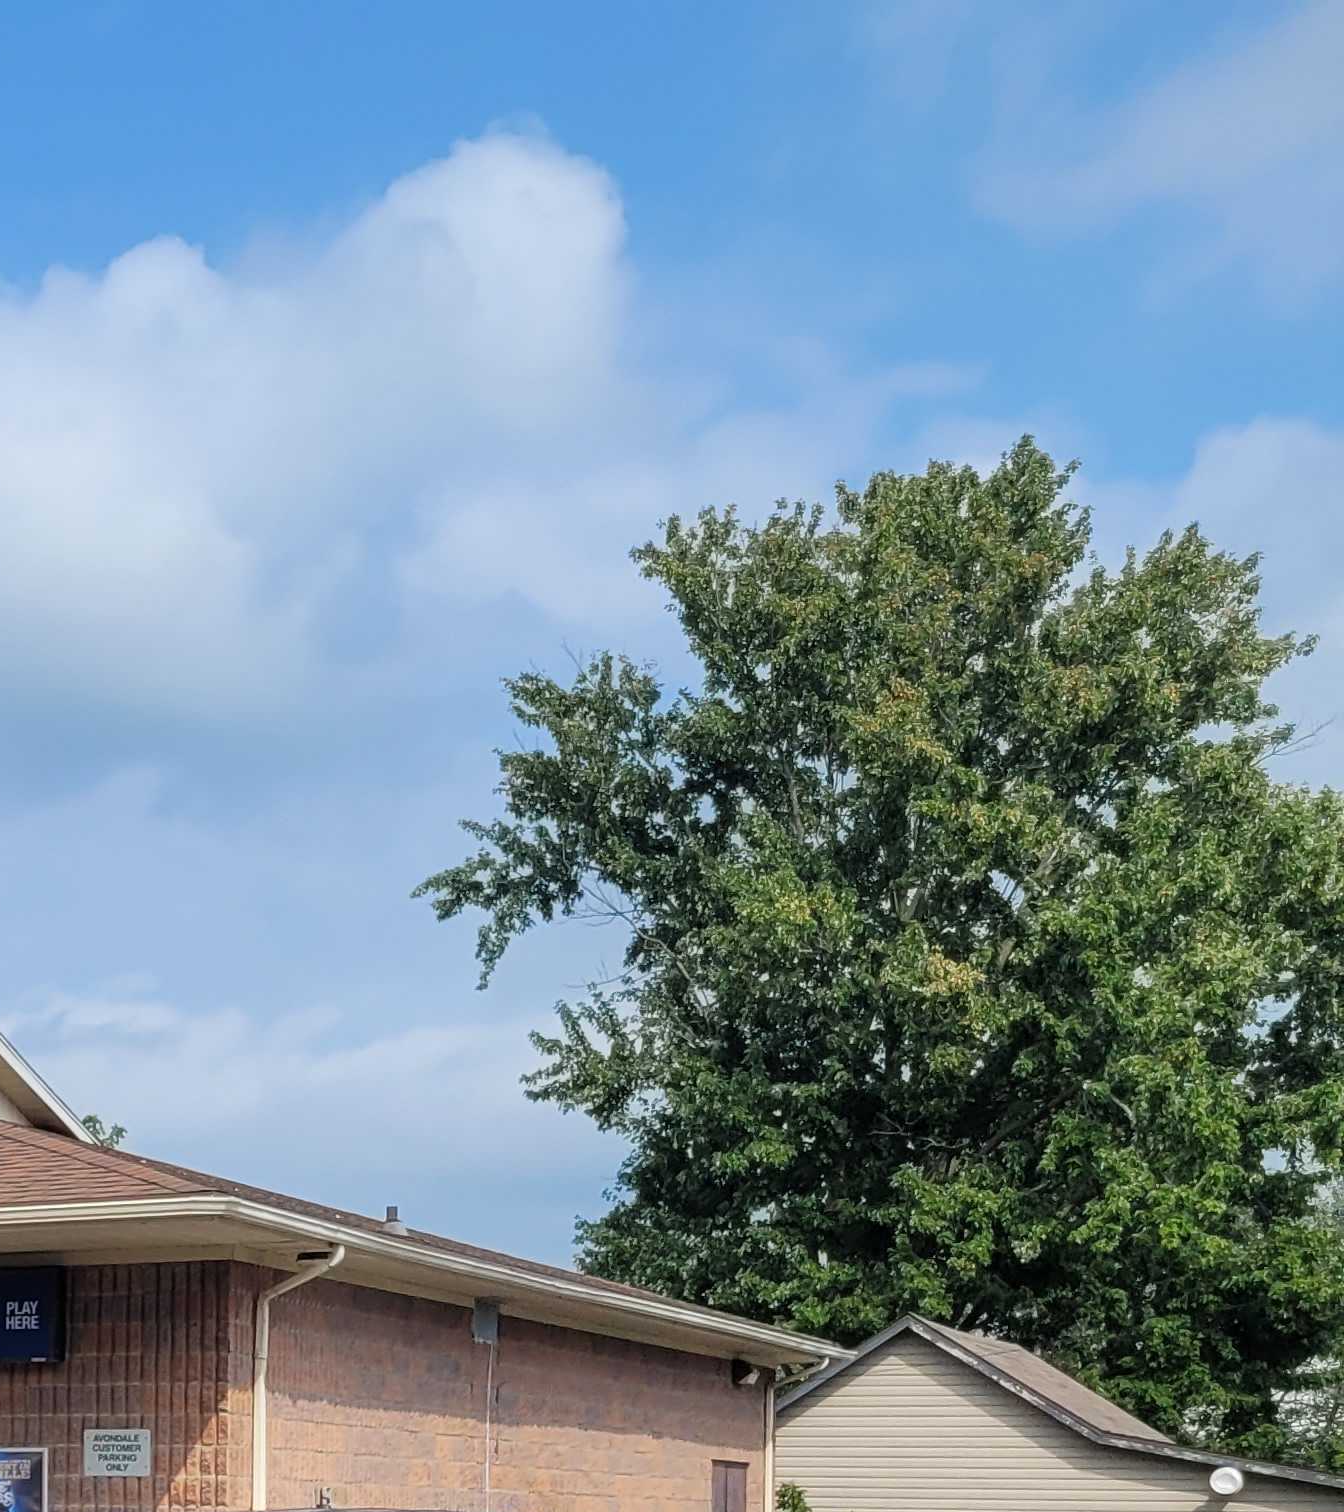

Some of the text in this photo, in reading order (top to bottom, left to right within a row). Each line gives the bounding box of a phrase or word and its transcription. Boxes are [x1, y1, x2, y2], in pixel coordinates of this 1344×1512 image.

[6, 1301, 40, 1315] PLAY
[6, 1315, 40, 1330] HERE
[93, 1433, 140, 1442] AVONDALE
[92, 1443, 142, 1453] CUSTOMER
[97, 1453, 137, 1462] PARKING
[105, 1463, 128, 1472] ONLY
